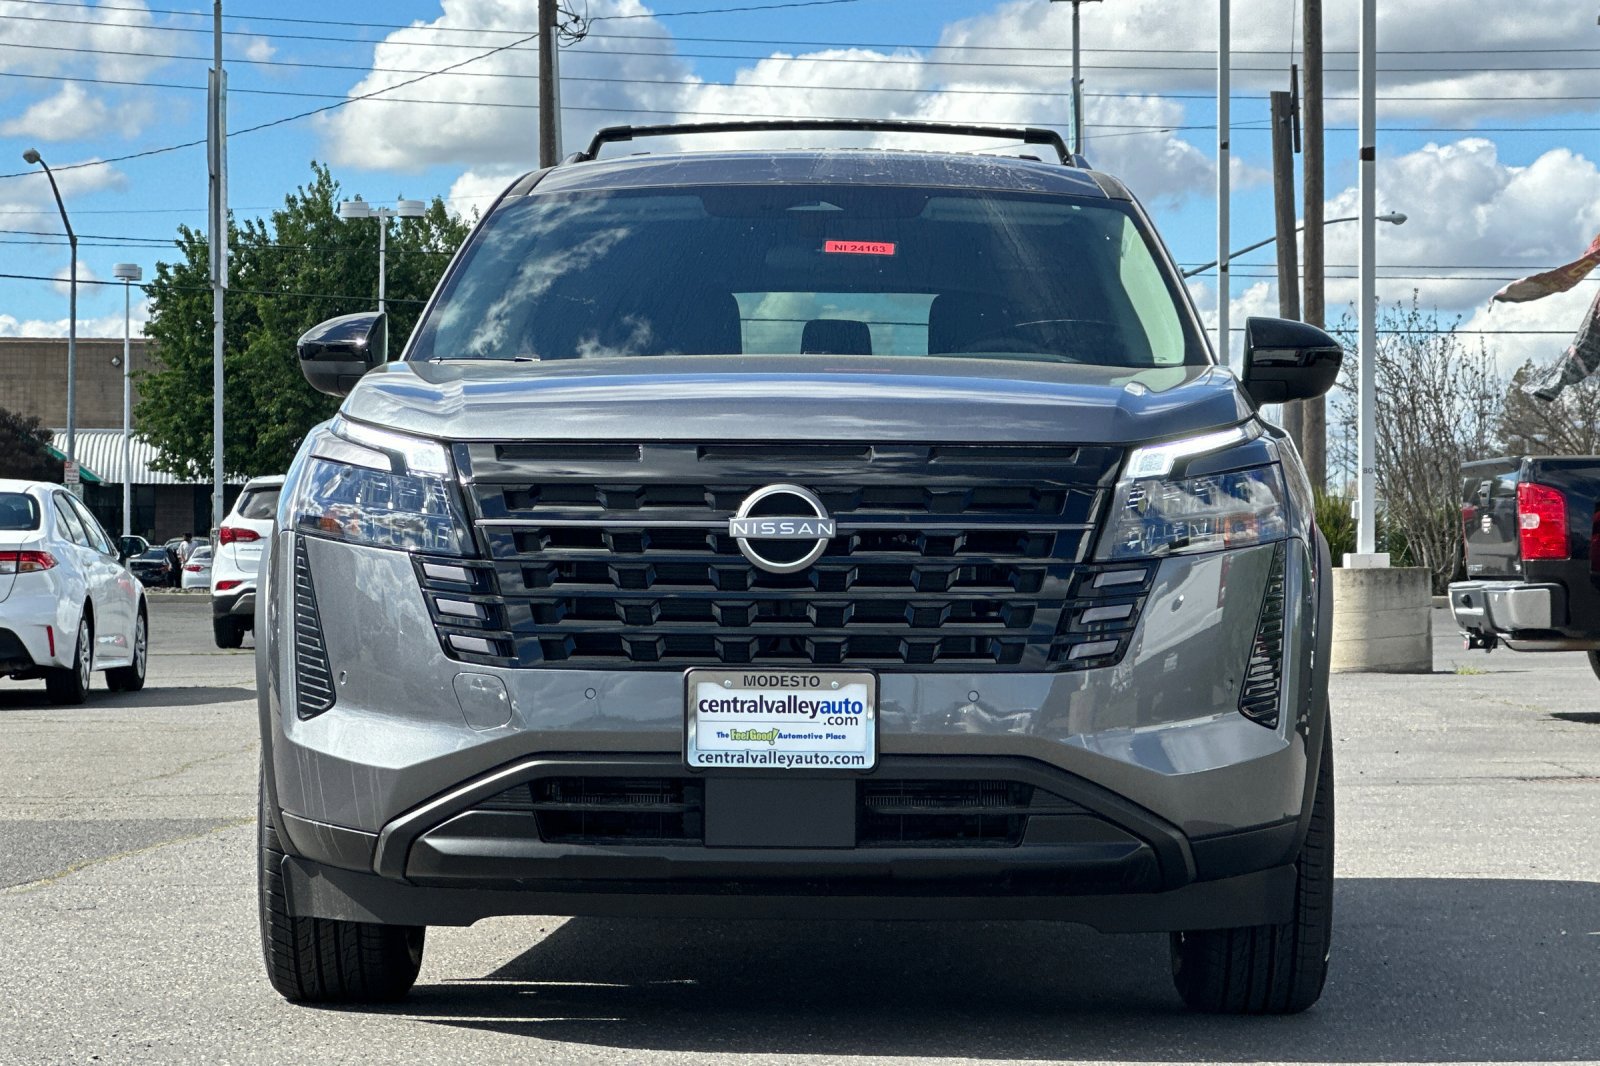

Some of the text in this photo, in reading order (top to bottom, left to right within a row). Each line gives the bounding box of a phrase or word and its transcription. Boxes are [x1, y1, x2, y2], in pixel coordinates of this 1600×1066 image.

[850, 244, 886, 252] 24163
[733, 522, 833, 535] NISSAN
[743, 675, 820, 688] MODESTO
[698, 695, 863, 719] centralvalleyauto
[823, 716, 859, 726] .com
[777, 732, 823, 740] Automotive
[697, 750, 865, 768] centralvalleyauto.com
